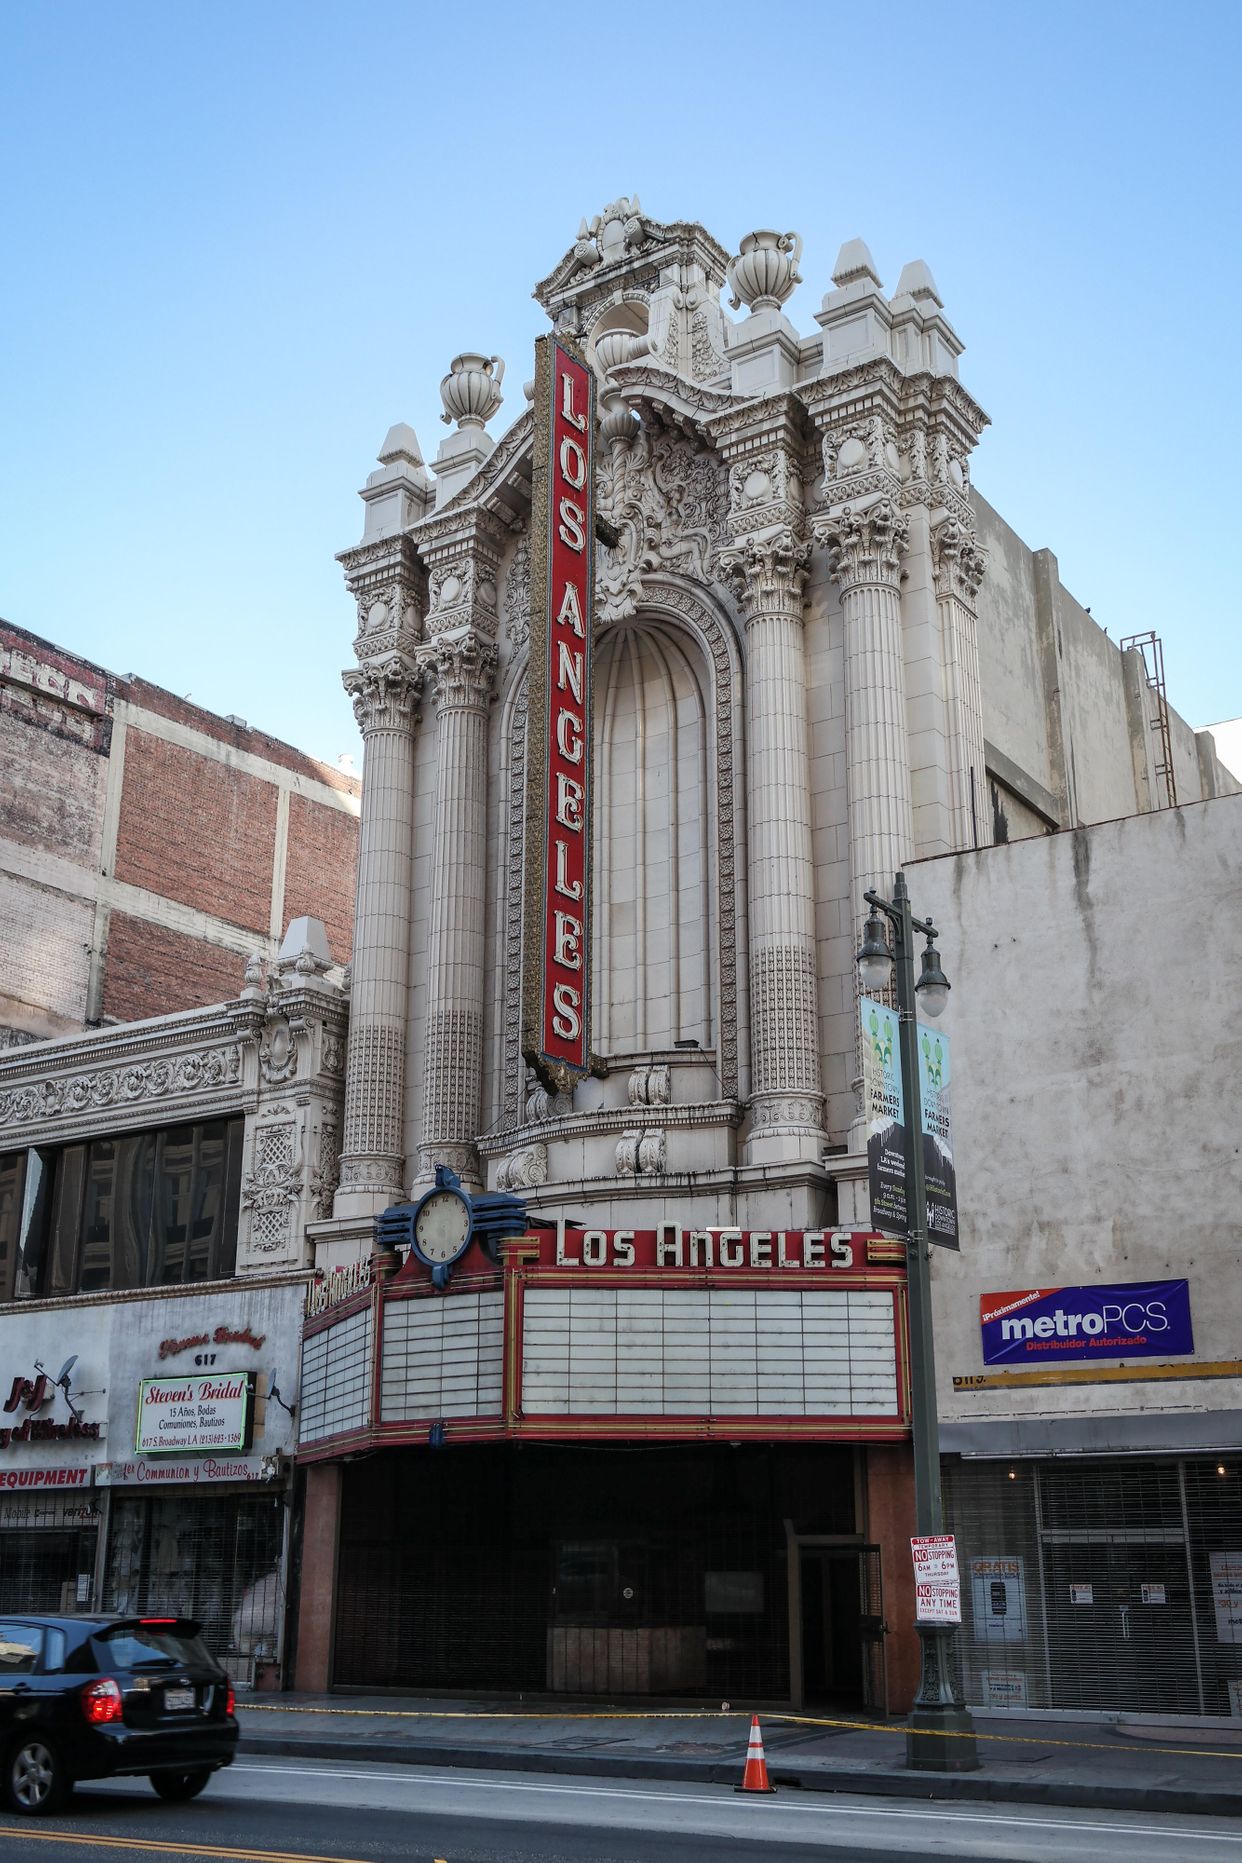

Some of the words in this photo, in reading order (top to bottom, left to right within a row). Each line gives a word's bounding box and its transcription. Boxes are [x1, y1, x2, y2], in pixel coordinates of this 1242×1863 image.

[559, 373, 588, 554] LOS
[552, 580, 586, 1040] ANGELES
[870, 1088, 900, 1107] FARMERS
[871, 1102, 899, 1120] MARKET
[924, 1109, 950, 1127] FARMERS
[926, 1122, 949, 1139] MARKET
[442, 1194, 449, 1202] 12
[1026, 1339, 1086, 1352] Distribuidor
[1089, 1335, 1148, 1348] Autorizado
[195, 1354, 216, 1366] 617
[145, 1384, 193, 1404] Steven's
[199, 1380, 244, 1401] Bridal
[170, 1408, 177, 1418] 15
[178, 1406, 196, 1418] Años,
[198, 1405, 217, 1416] Bodas
[159, 1419, 198, 1430] Comuniones,
[200, 1417, 225, 1428] Bautizos
[142, 1437, 153, 1447] 617
[158, 1435, 187, 1448] Broadway
[0, 1469, 88, 1488] EQUIPMENT
[136, 1461, 190, 1482] Communion
[193, 1466, 199, 1483] y
[203, 1459, 248, 1479] Bautizos
[914, 1550, 928, 1562] NO
[929, 1549, 955, 1561] STOPPING
[918, 1585, 931, 1597] NO
[932, 1587, 959, 1599] STOPPING
[920, 1598, 936, 1607] ANY
[939, 1599, 958, 1609] TIME
